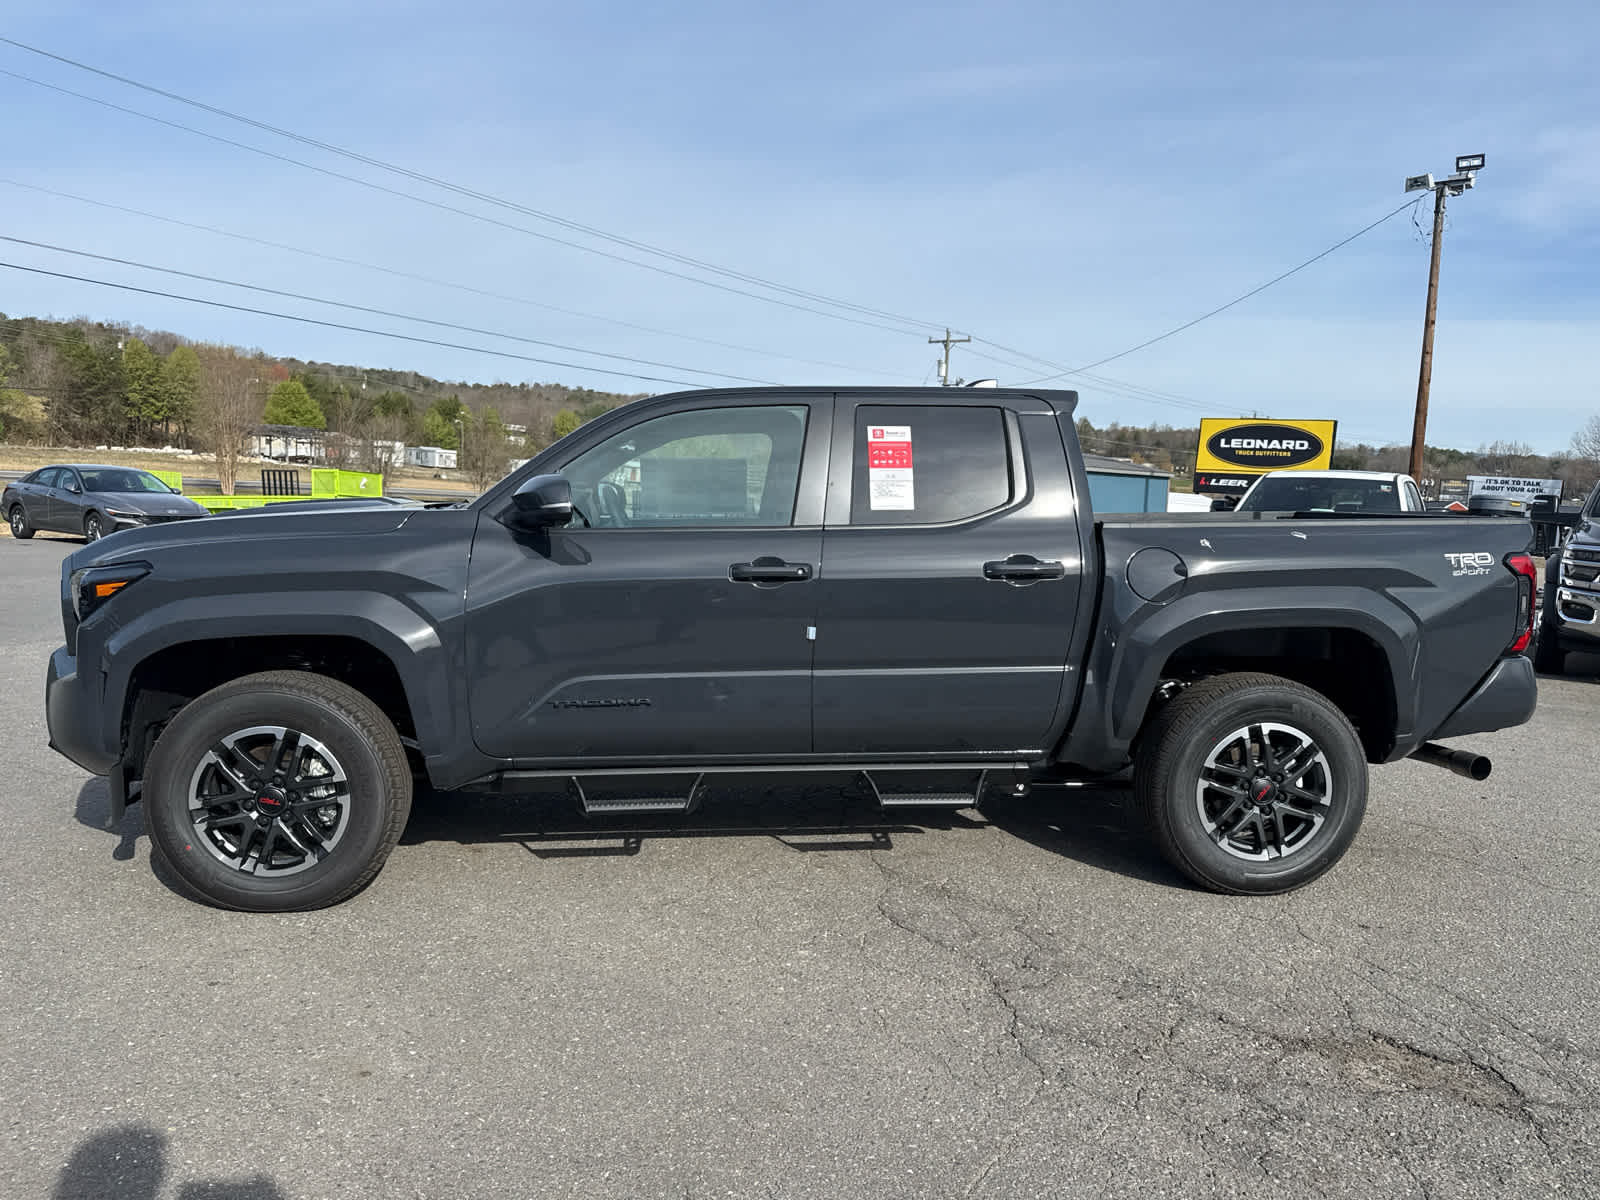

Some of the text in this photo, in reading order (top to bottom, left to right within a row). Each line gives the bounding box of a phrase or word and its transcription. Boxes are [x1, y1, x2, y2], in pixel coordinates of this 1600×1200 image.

[1220, 438, 1309, 450] LEONARD
[1210, 479, 1248, 487] LEER
[1443, 552, 1495, 568] TRD
[1452, 568, 1491, 577] SPORT
[547, 698, 651, 708] TACOMA
